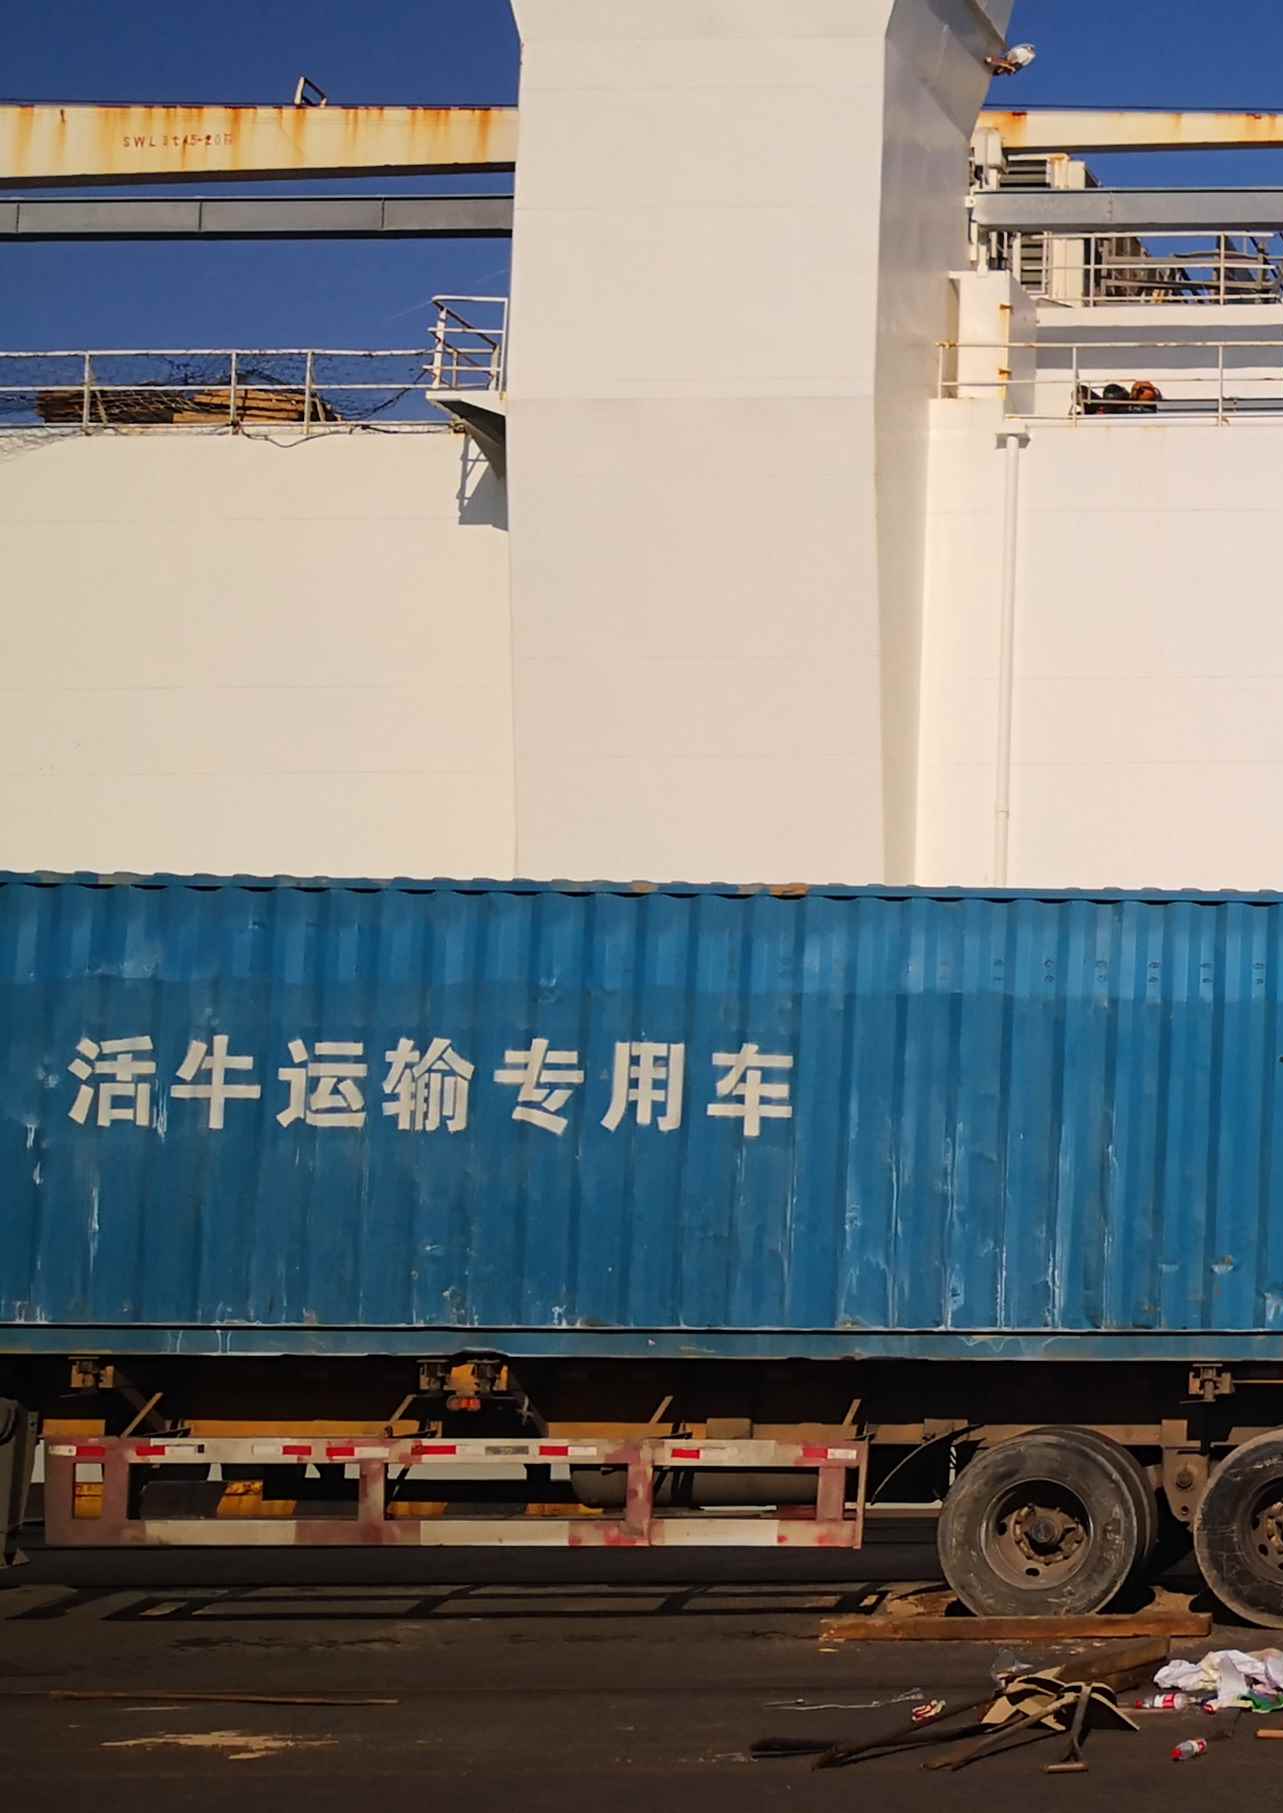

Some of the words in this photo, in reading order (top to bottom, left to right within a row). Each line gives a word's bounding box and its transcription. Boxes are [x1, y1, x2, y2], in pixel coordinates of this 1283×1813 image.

[122, 136, 157, 148] SWL
[67, 1035, 793, 1137] 活牛运输专用车
